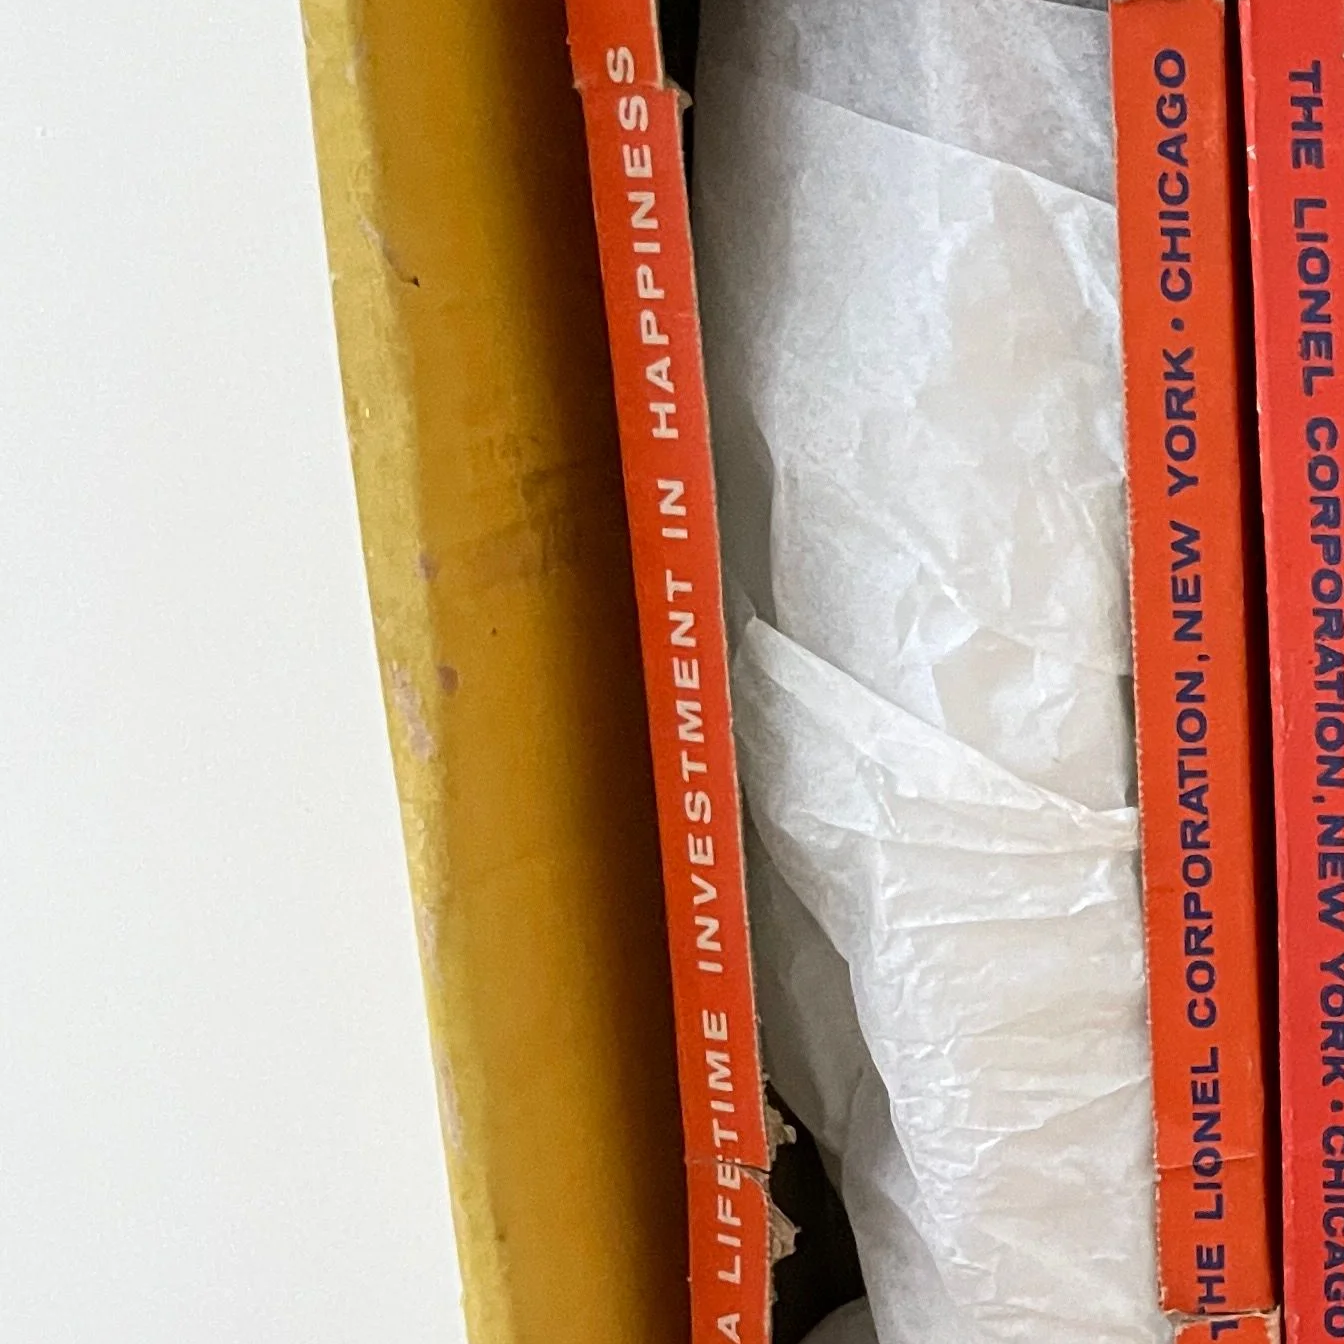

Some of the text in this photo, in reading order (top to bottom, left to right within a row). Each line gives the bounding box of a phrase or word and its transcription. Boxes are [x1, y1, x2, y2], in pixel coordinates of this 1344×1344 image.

[1153, 48, 1193, 302] CHICAGO
[1288, 59, 1325, 169] THE
[1293, 197, 1335, 397] LIONEL
[1162, 347, 1199, 497] YORK
[1169, 520, 1203, 642] NEW
[606, 46, 743, 1344] A LIFETIME INVESTMENT IN HAPPINESS
[1190, 1046, 1224, 1220] LIONEL
[1195, 1244, 1238, 1340] THE
